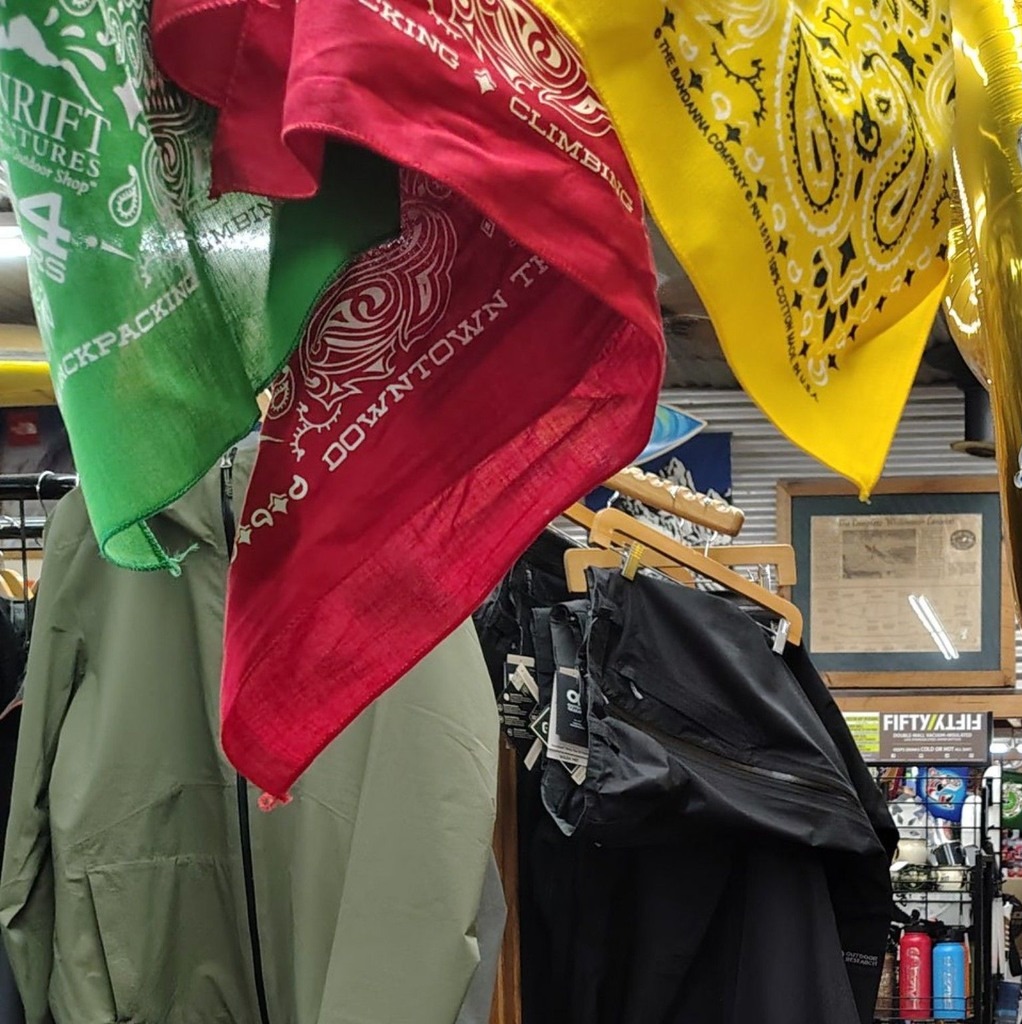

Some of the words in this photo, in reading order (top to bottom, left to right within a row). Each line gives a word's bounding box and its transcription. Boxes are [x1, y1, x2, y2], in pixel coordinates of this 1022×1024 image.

[508, 97, 635, 214] CLIMBING
[658, 38, 675, 65] THE
[670, 61, 709, 138] BANDANNA
[706, 132, 749, 192] COMPANY
[776, 286, 795, 328] COTTON
[322, 289, 509, 471] DOWNTOWN
[845, 951, 879, 961] OUTDOOR
